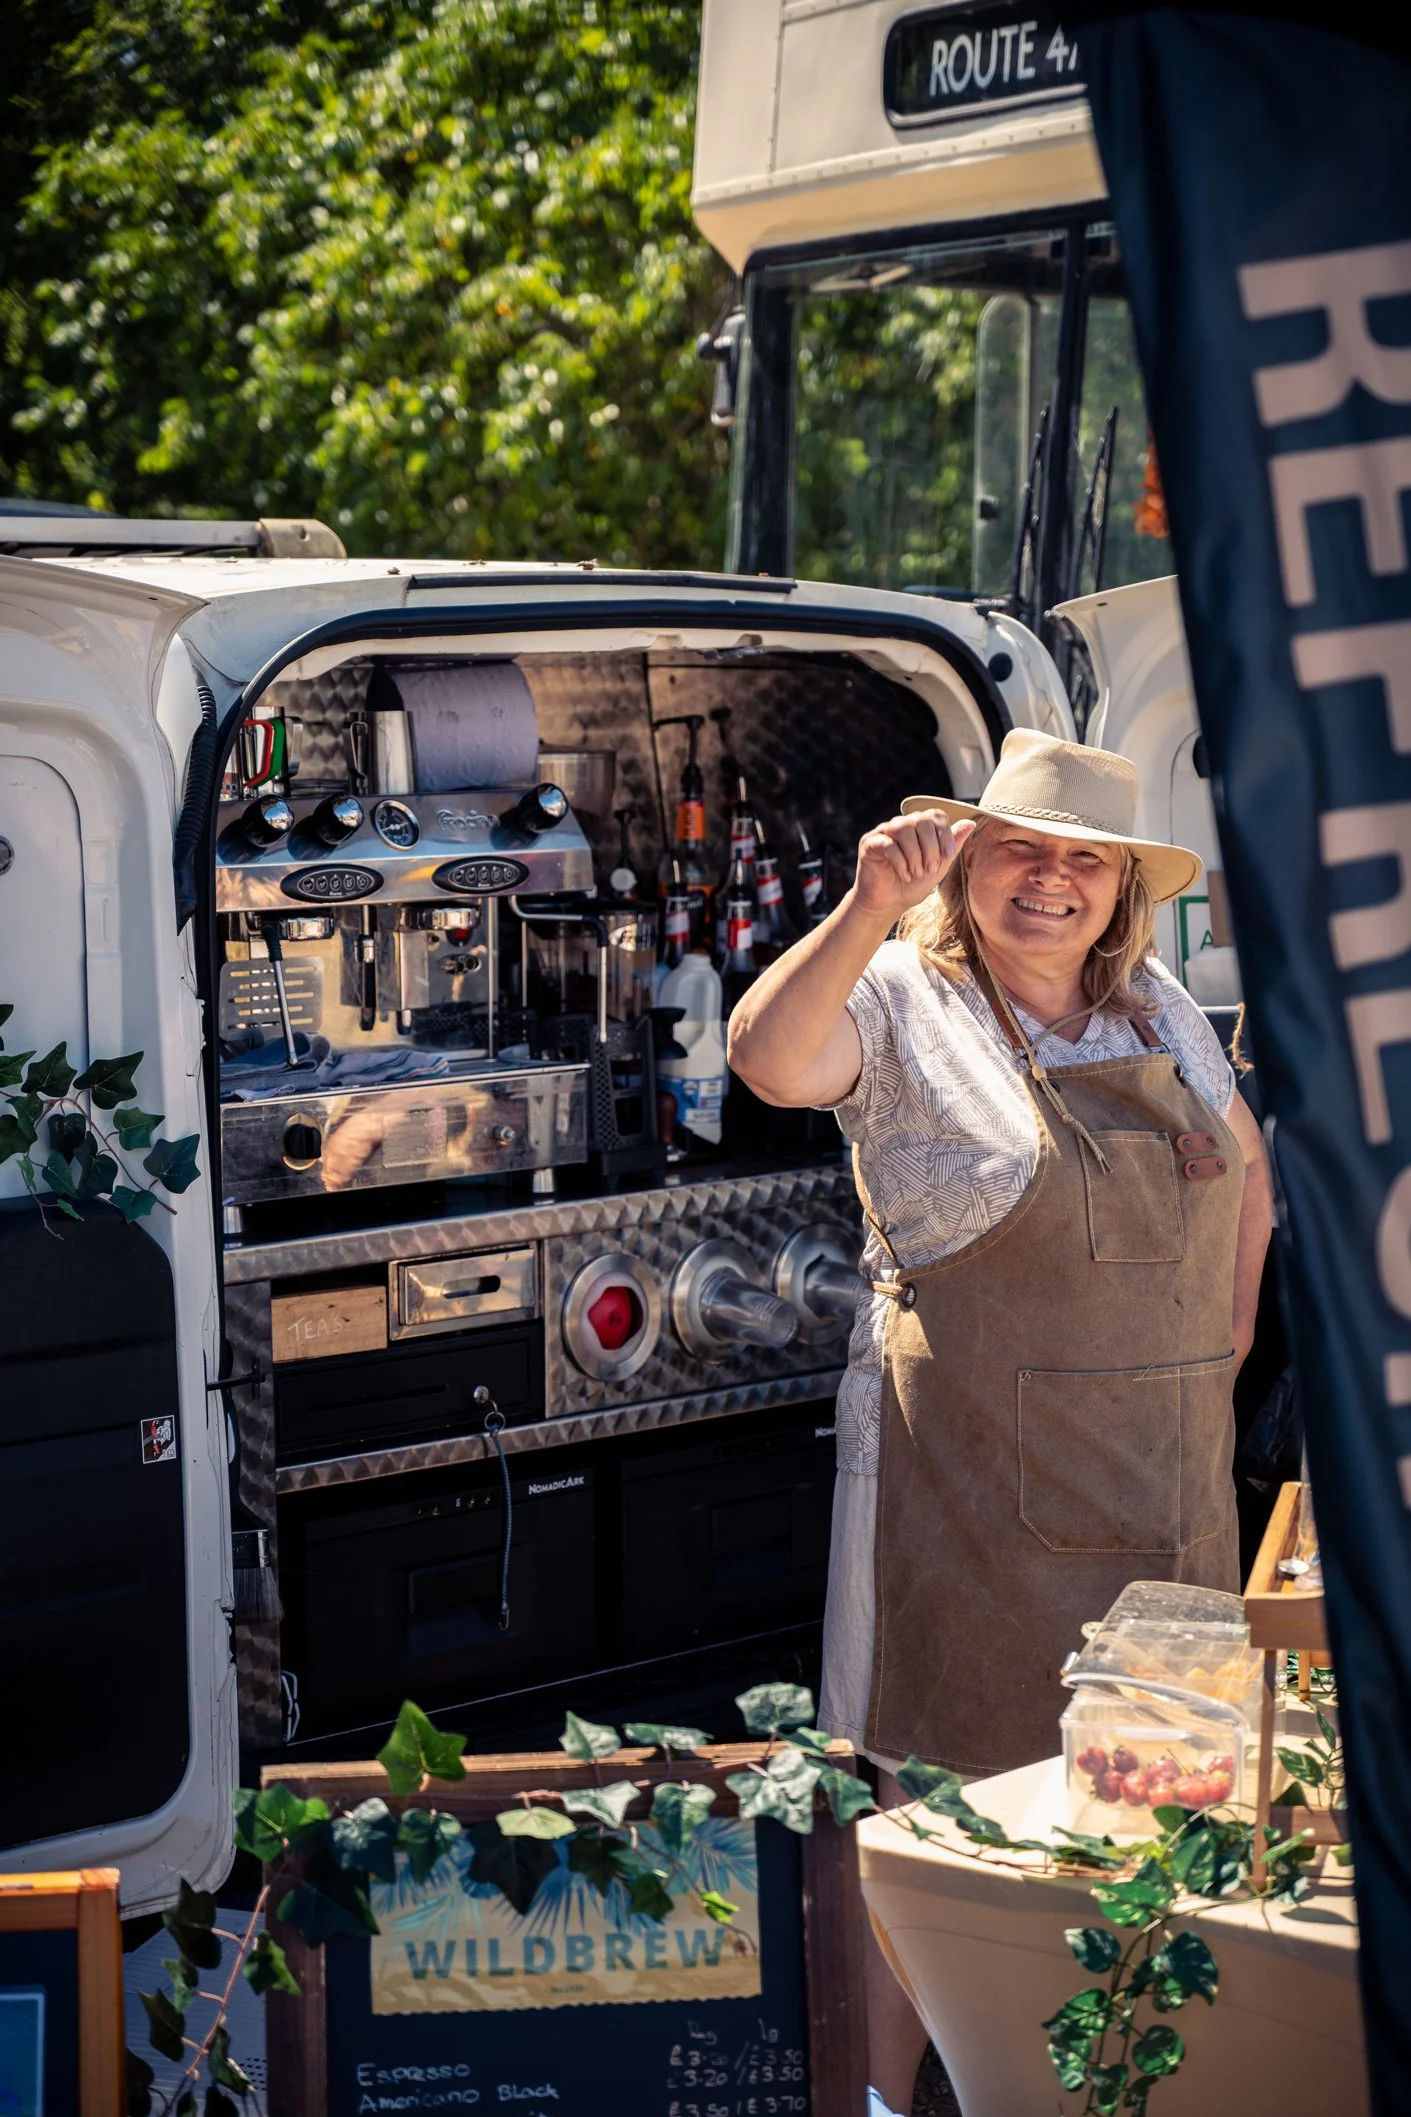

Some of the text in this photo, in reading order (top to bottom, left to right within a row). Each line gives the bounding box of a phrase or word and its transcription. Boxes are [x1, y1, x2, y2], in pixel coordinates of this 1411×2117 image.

[929, 20, 1038, 96] ROUTE
[287, 1315, 343, 1341] TEAS
[404, 1928, 726, 1979] WILDBREW
[358, 2087, 480, 2114] Americano
